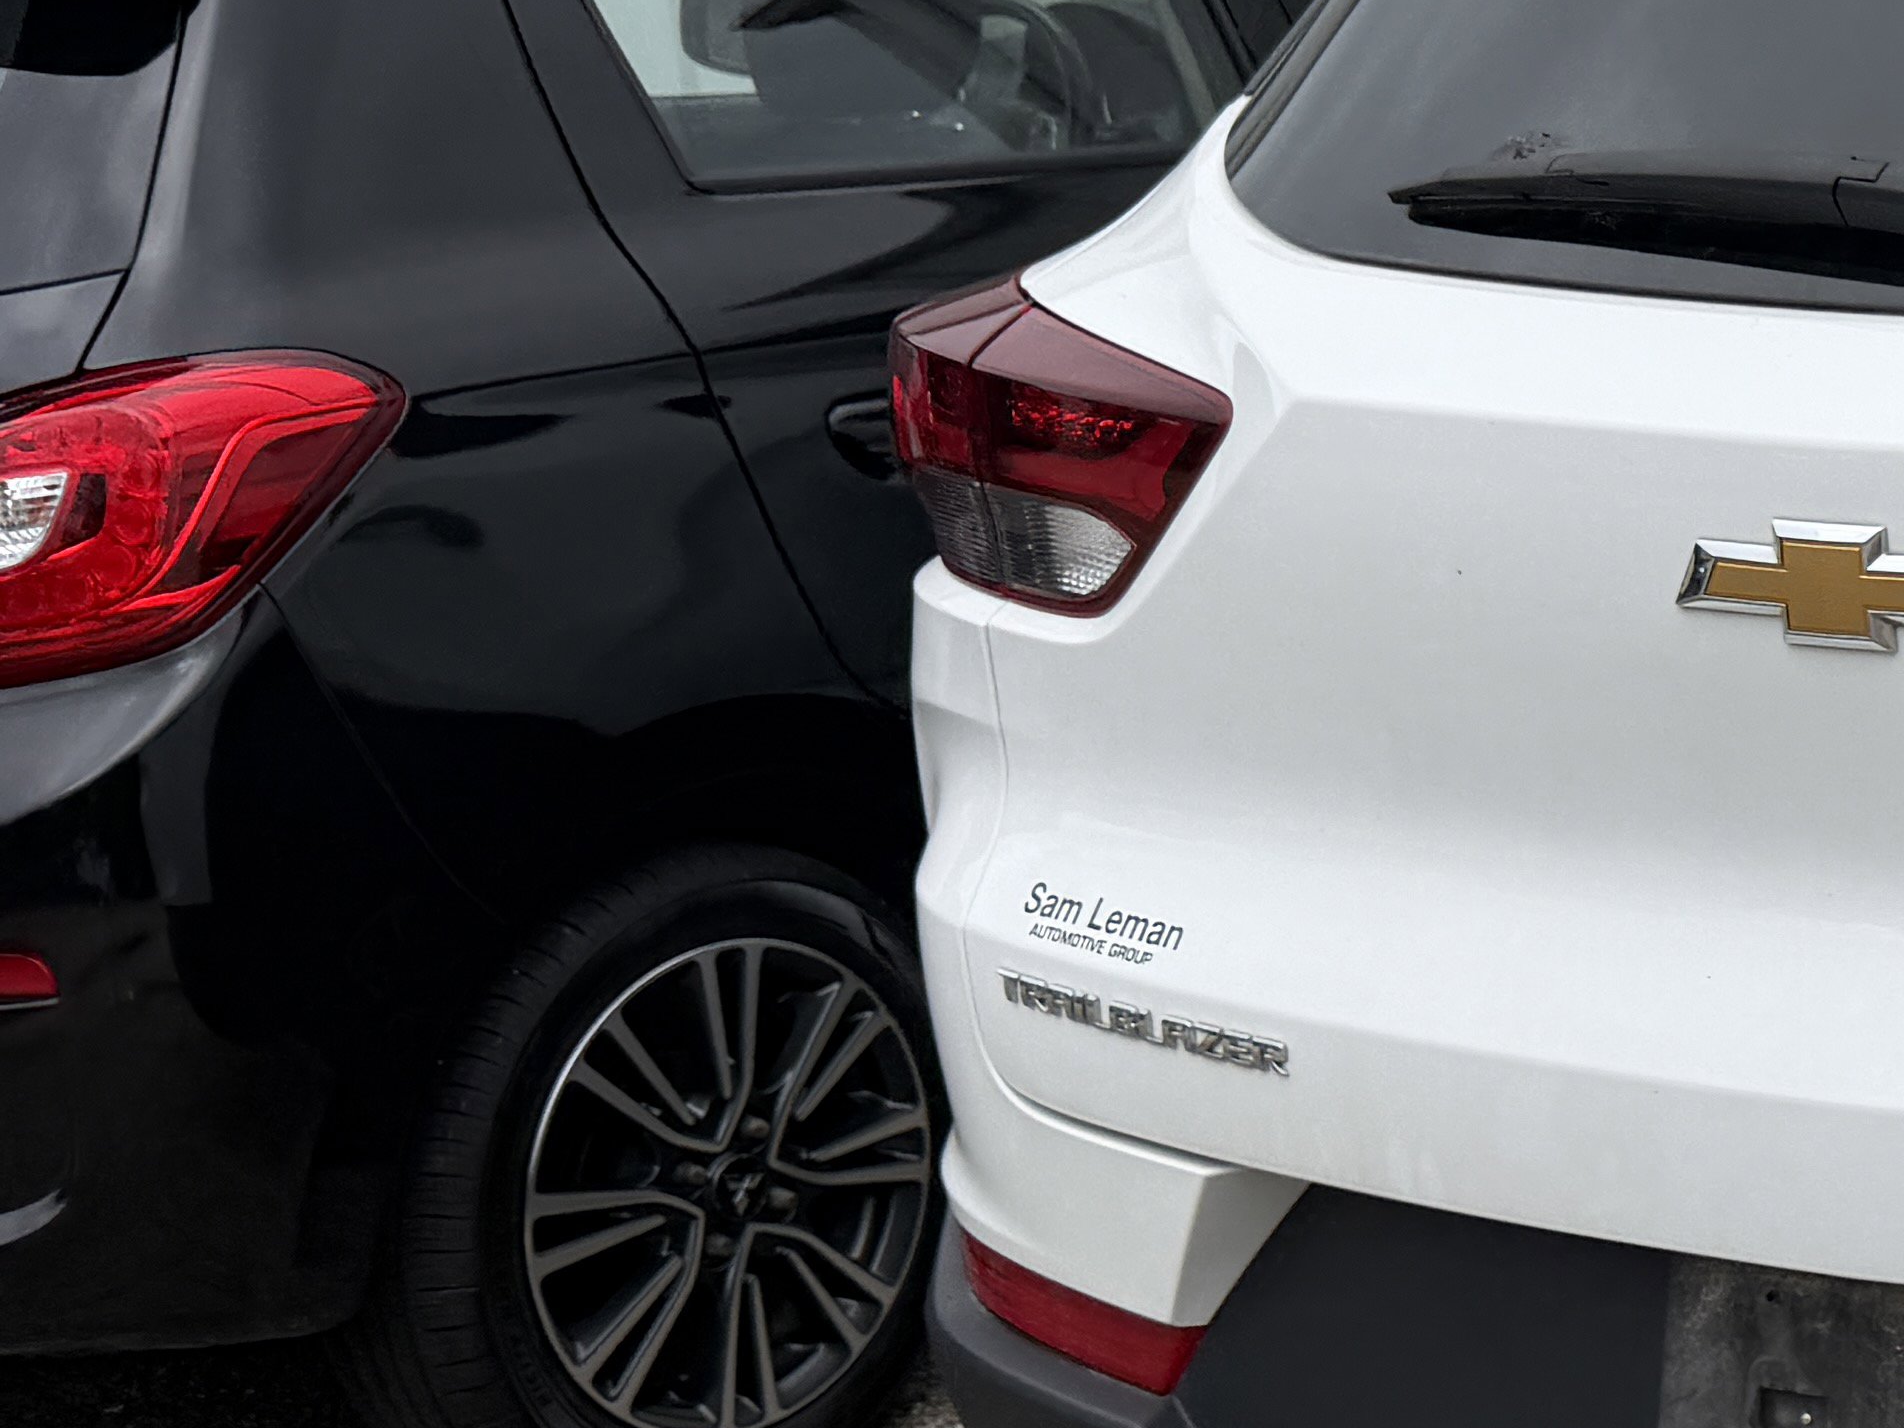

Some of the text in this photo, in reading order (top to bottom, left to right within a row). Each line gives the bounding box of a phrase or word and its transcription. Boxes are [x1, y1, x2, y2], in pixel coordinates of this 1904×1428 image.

[1024, 882, 1184, 950] Sam Leman
[1029, 923, 1153, 965] AUTOMOTIVE GROUP
[997, 967, 1290, 1076] TRAILBLAZER
